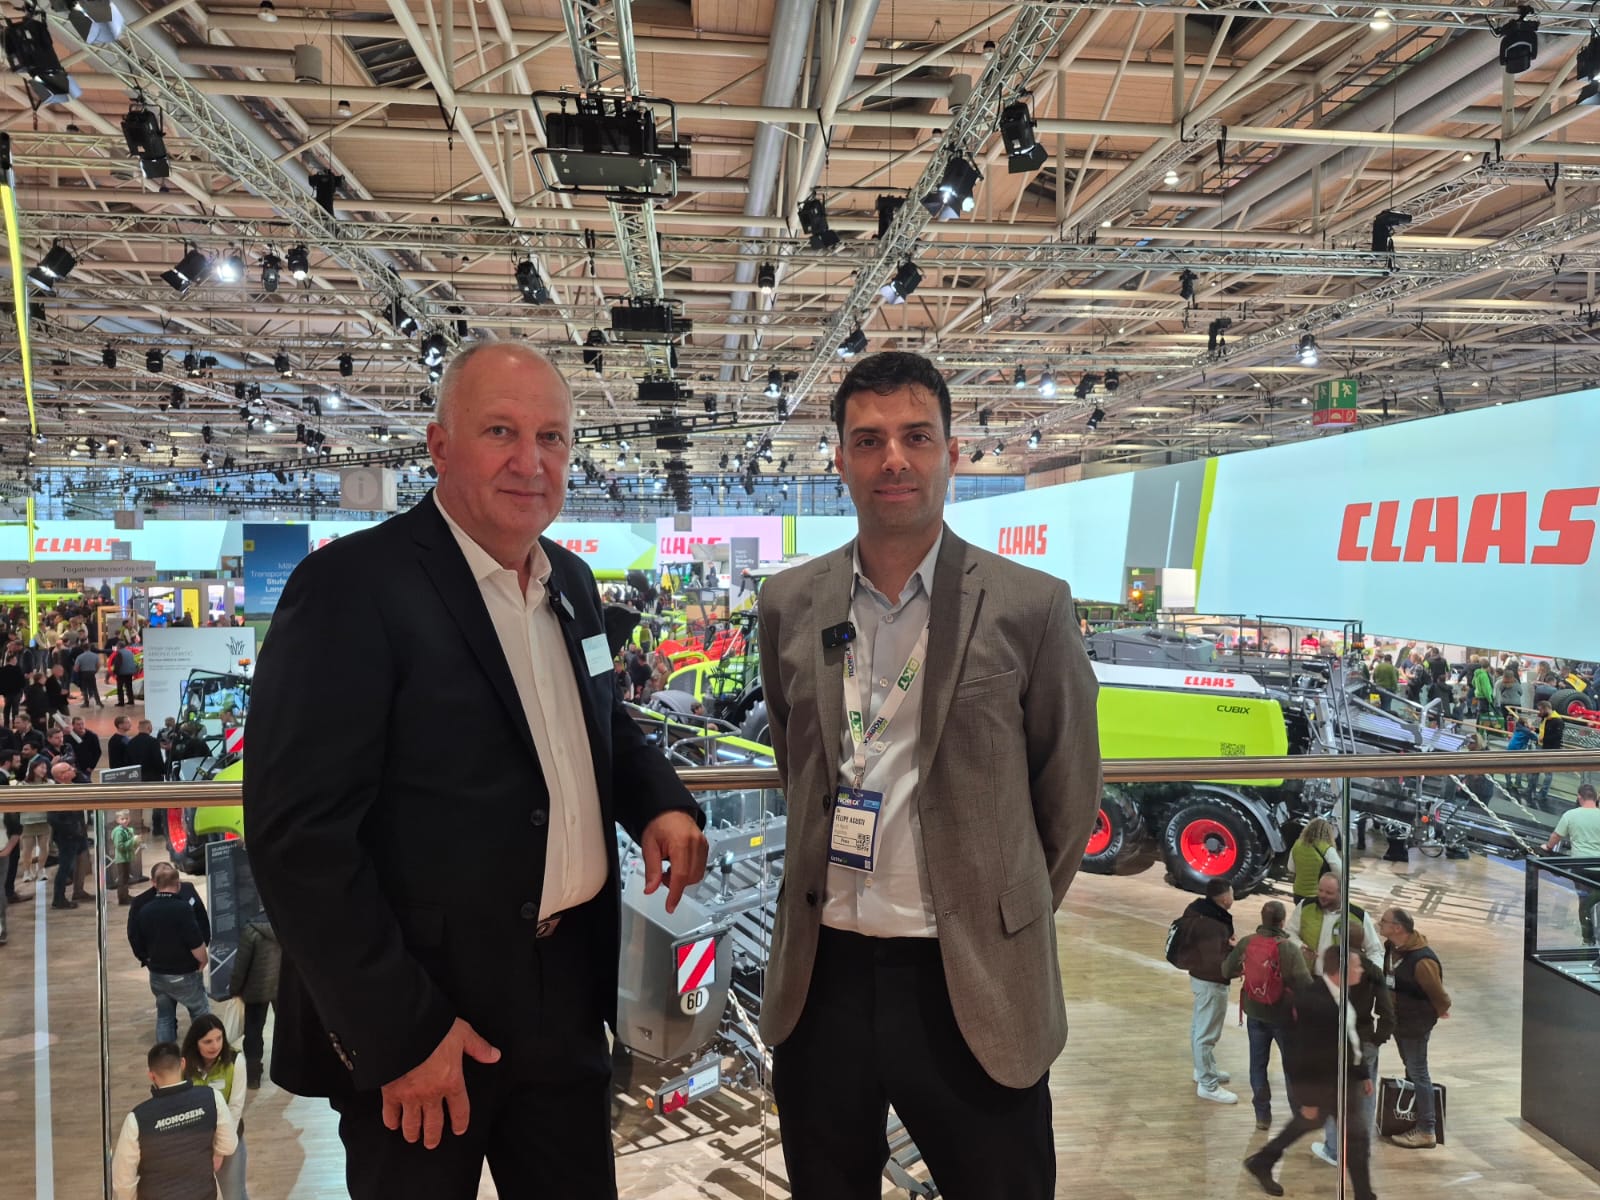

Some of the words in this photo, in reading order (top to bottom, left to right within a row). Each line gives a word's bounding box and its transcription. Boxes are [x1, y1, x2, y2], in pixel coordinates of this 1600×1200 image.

[1337, 487, 1600, 564] CLAAS
[998, 524, 1048, 555] CLAAS
[1183, 675, 1236, 688] CLAAS
[1216, 705, 1251, 714] CUBIX
[687, 990, 703, 1010] 60
[154, 1107, 206, 1129] MONOSEM
